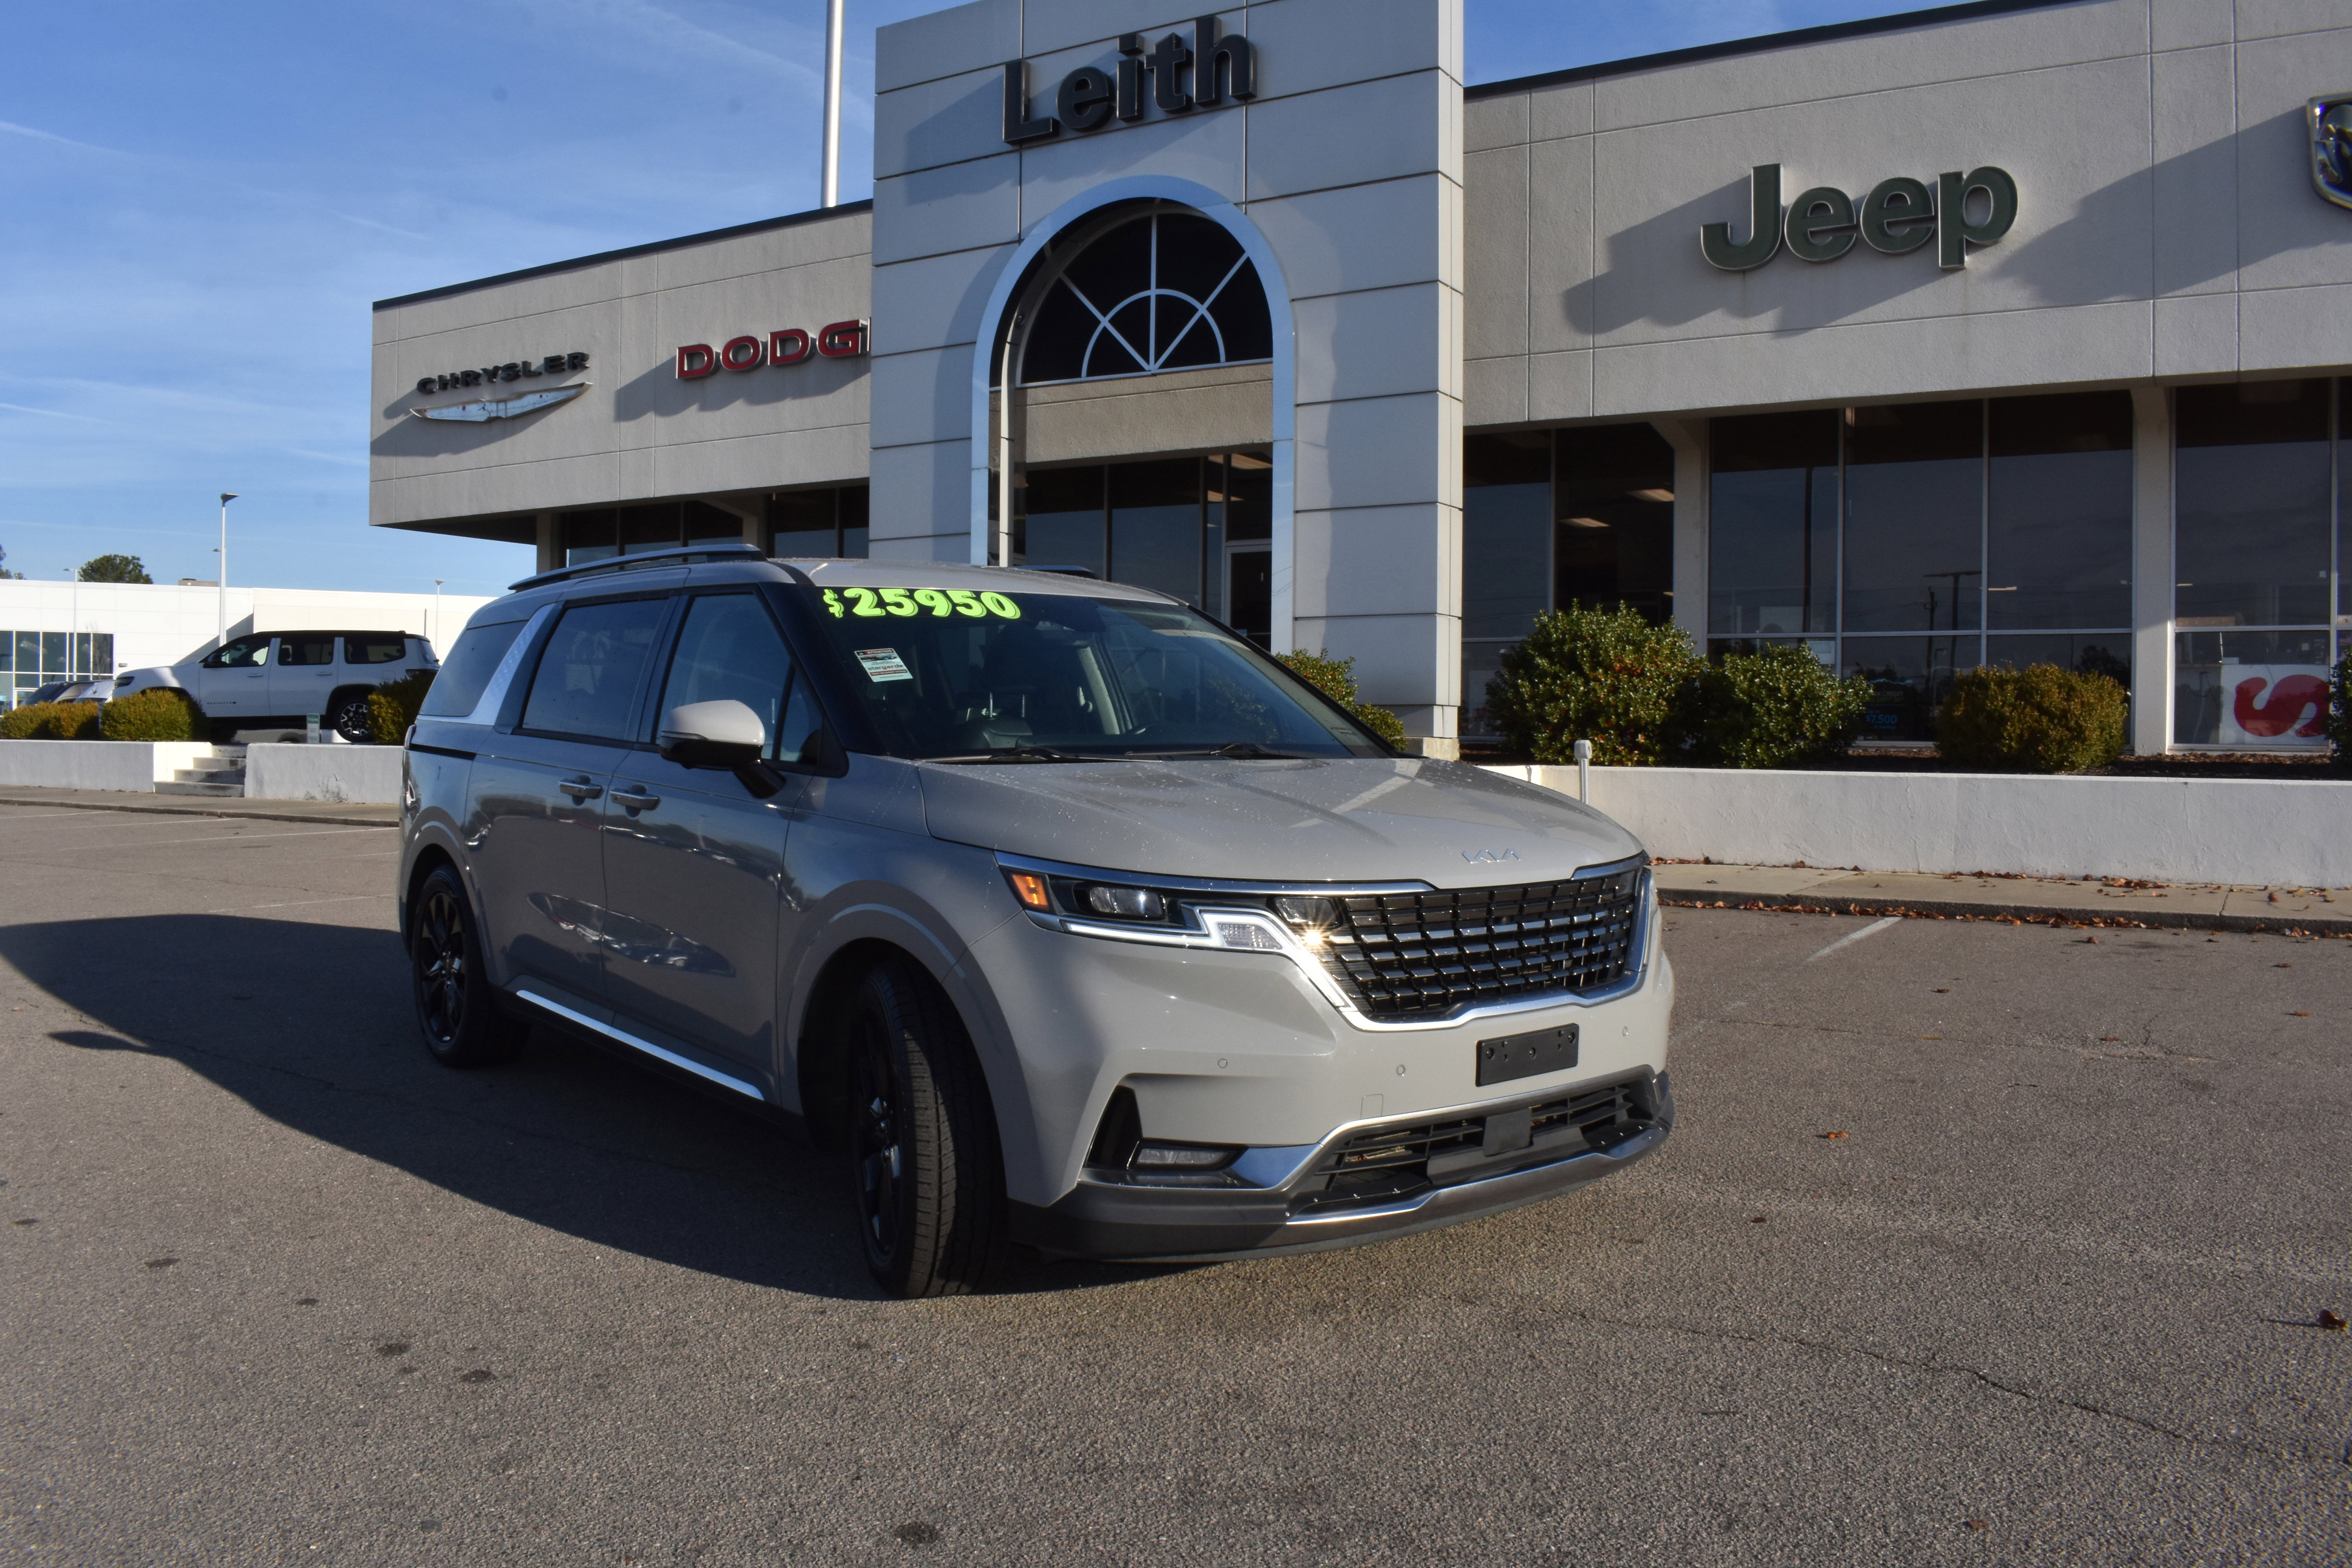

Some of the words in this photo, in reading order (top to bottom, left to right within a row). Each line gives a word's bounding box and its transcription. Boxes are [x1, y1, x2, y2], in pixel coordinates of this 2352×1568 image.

[1003, 15, 1256, 145] Leith
[1701, 163, 2018, 271] Jeep
[416, 352, 590, 394] CHRYSLER
[676, 316, 871, 379] DODG
[823, 588, 1021, 619] $25950
[1866, 715, 1898, 724] $7,500
